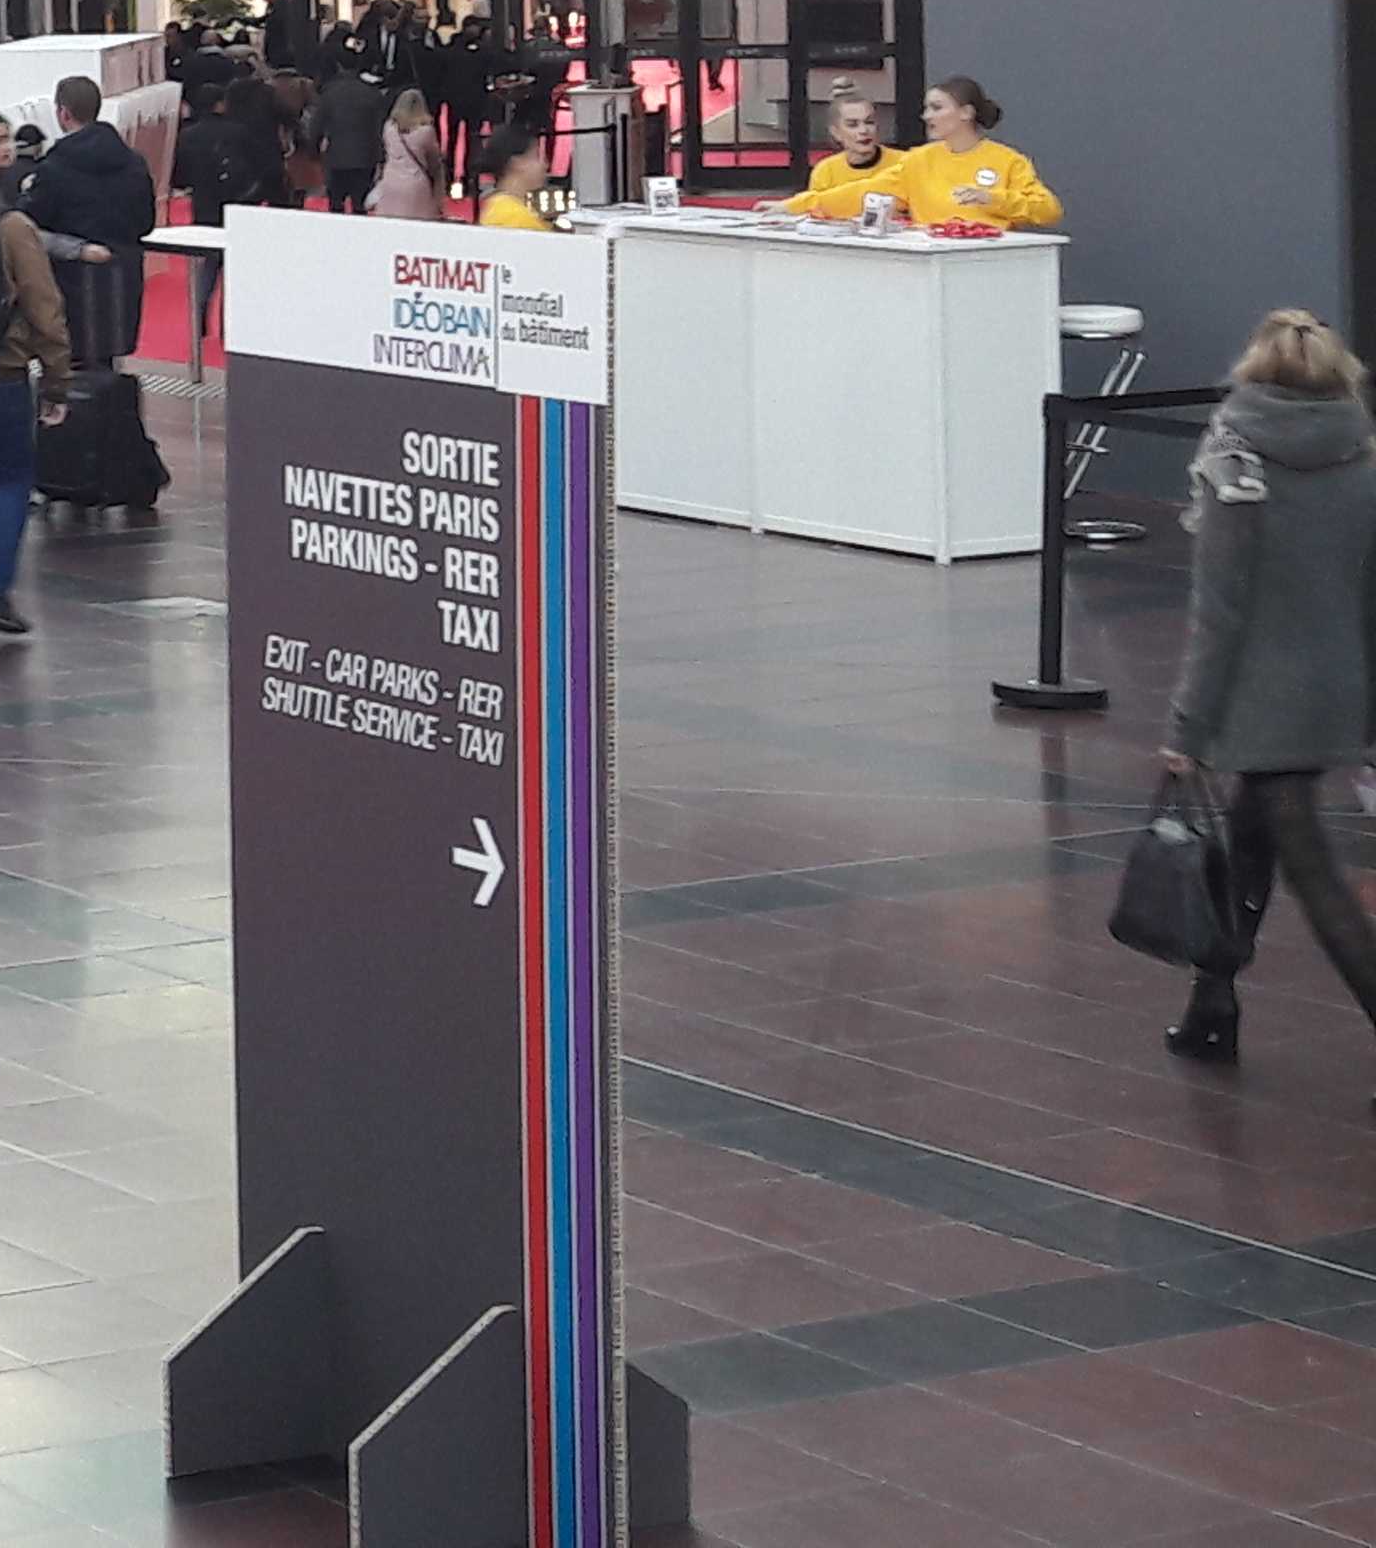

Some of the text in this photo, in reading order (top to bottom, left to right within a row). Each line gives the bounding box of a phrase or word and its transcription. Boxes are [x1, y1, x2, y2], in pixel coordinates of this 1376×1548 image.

[373, 335, 491, 379] INTERCLIMA
[518, 319, 590, 351] bâtiment
[393, 292, 563, 338] IDÉOBAIN mondial
[402, 431, 501, 486] SORTIE
[284, 465, 499, 541] NAVETTES PARIS
[291, 519, 418, 581] PARKINGS
[444, 547, 500, 598] RER
[438, 600, 501, 652] TAXI
[265, 635, 309, 674] EXIT
[326, 649, 366, 689] CAR
[371, 658, 439, 705] PARKS
[458, 679, 503, 720] RER
[262, 677, 348, 727] SHUTTLE
[352, 700, 438, 751] SERVICE
[458, 723, 504, 765] TAXI
